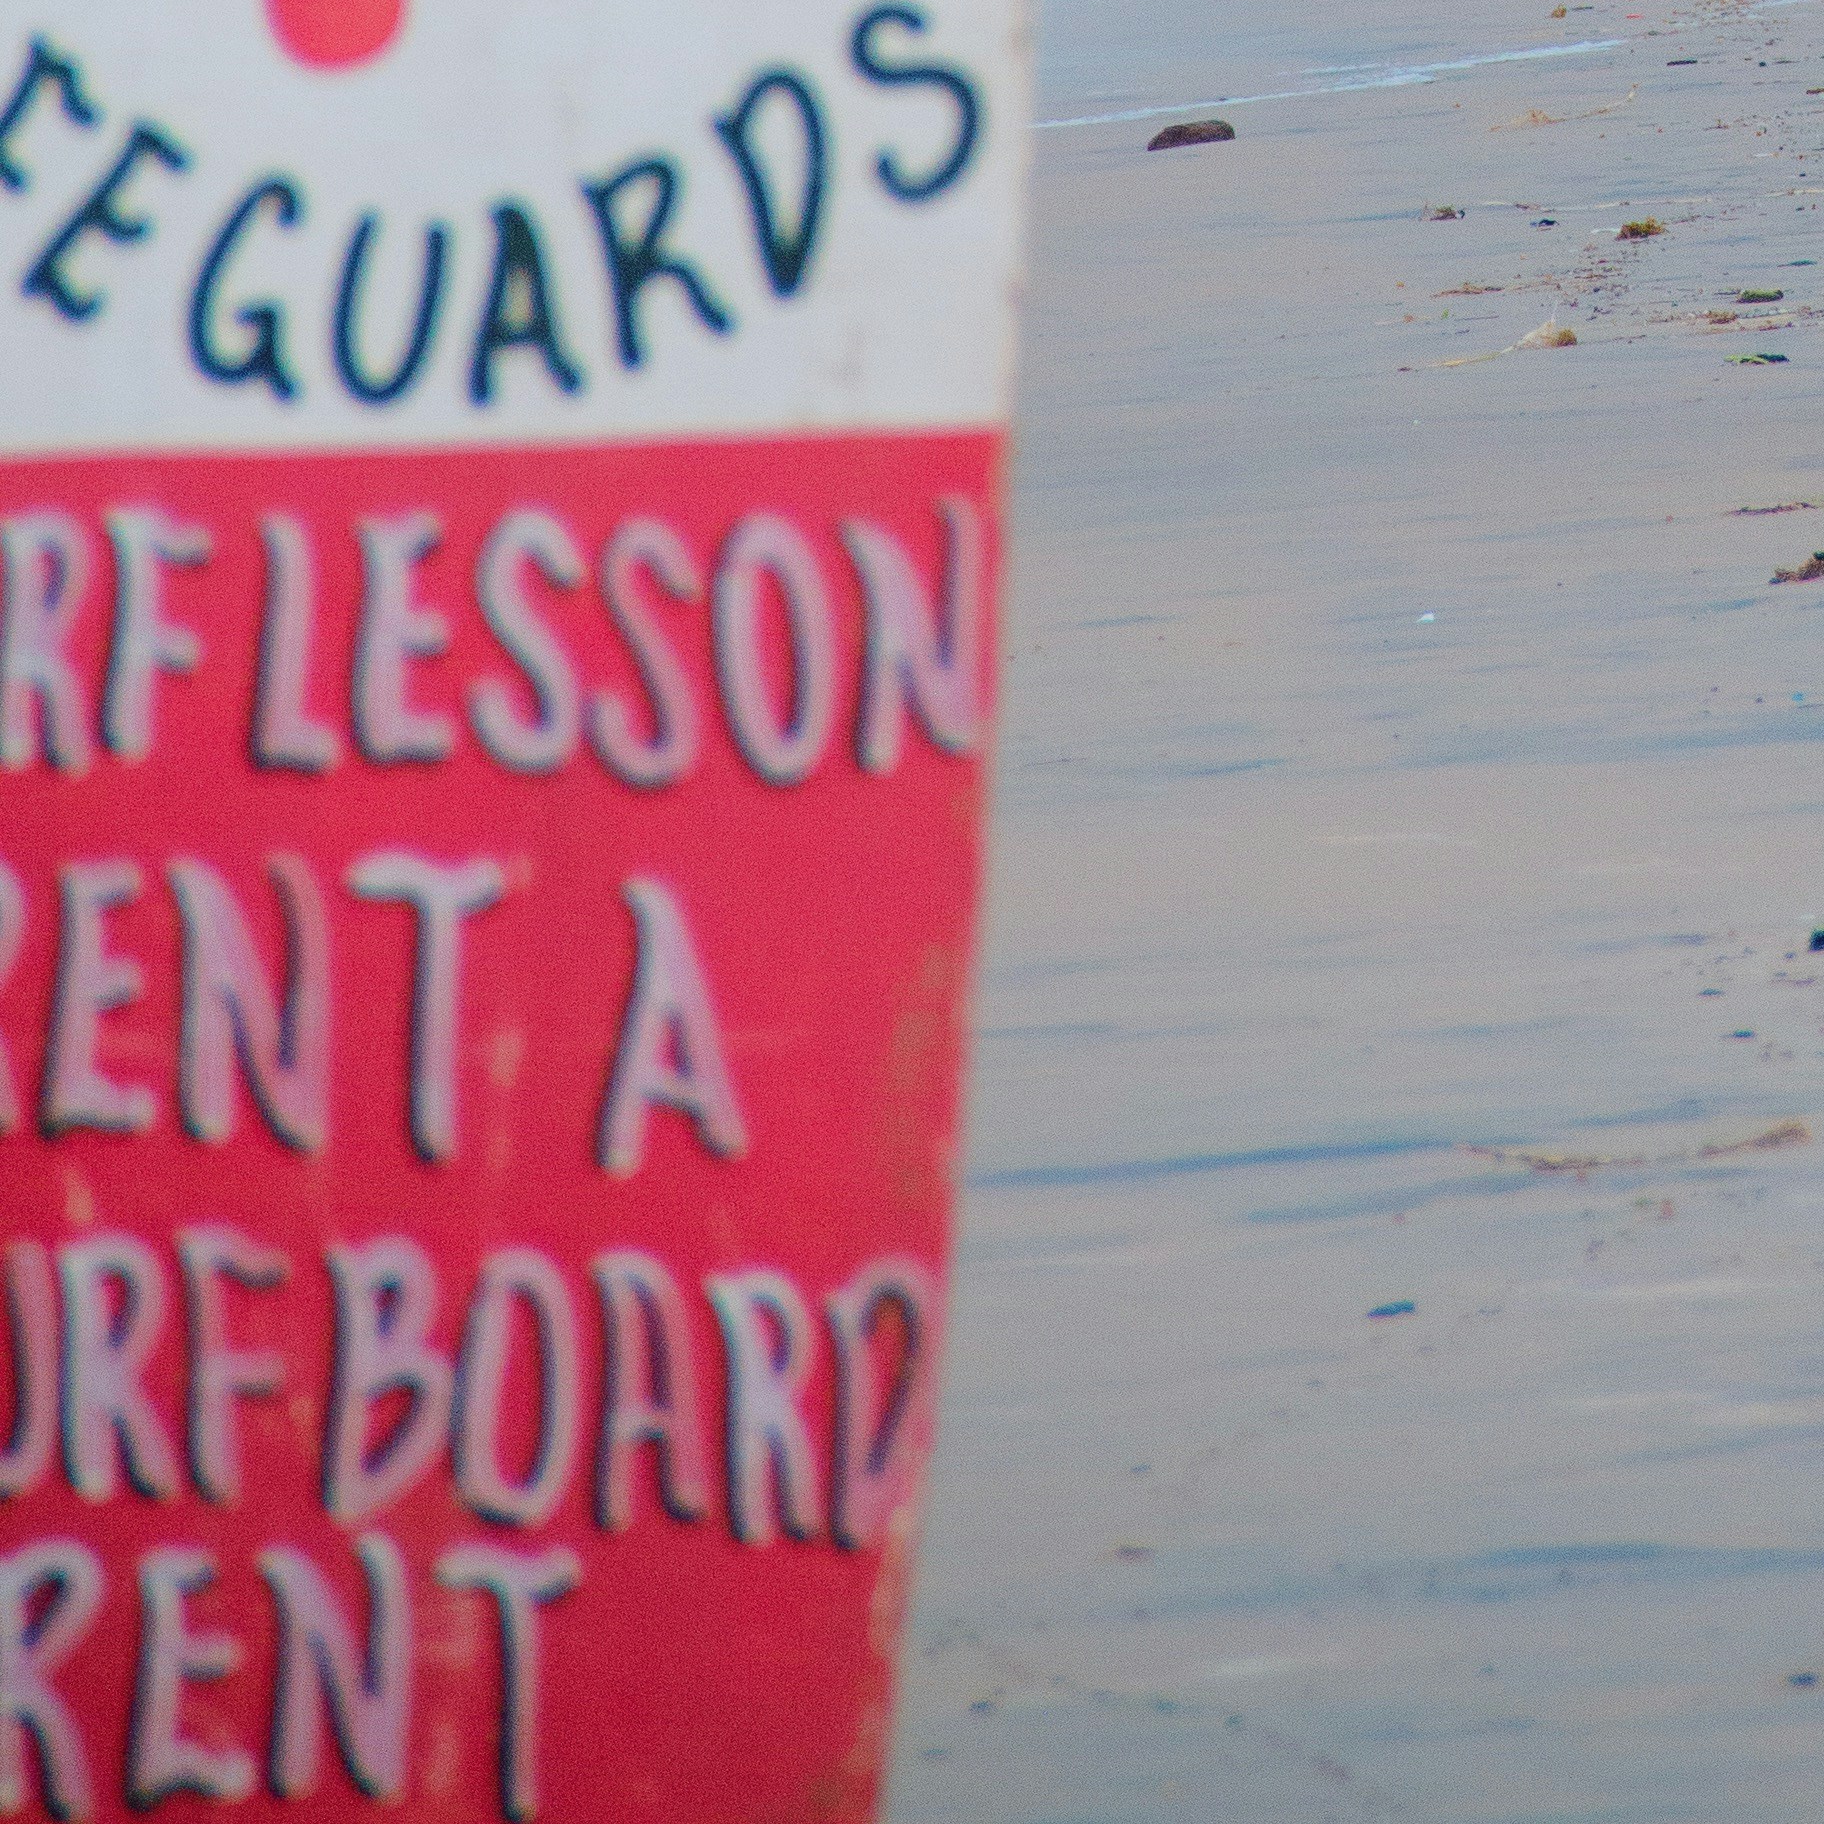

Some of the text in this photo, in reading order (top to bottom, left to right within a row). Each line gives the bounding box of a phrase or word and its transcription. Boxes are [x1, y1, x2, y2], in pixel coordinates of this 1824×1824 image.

[0, 849, 748, 1177] ENT A
[0, 1532, 582, 1822] RENT
